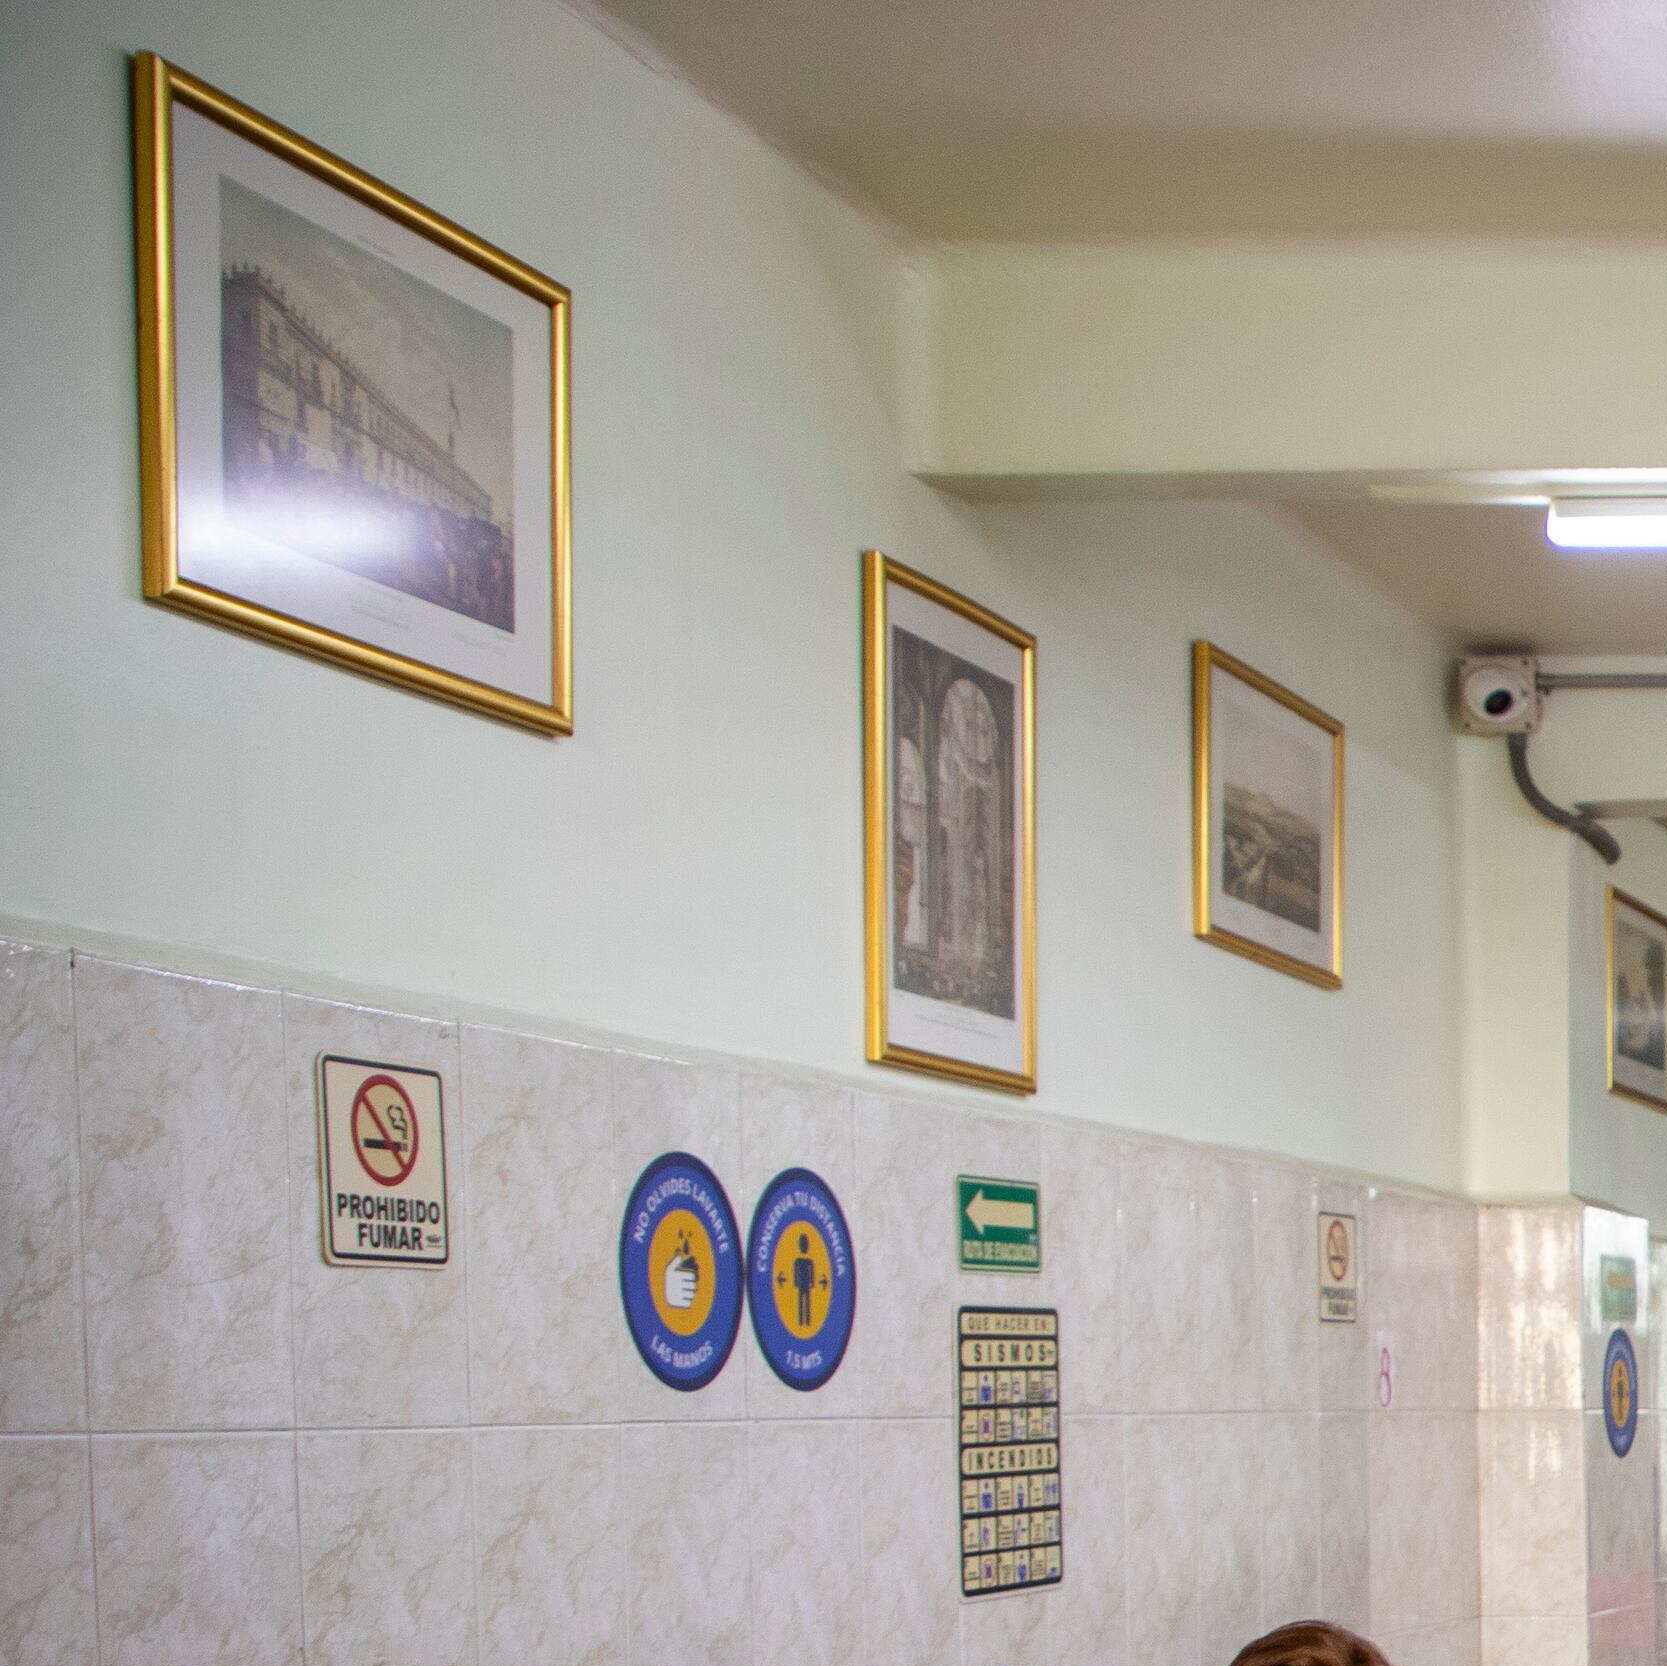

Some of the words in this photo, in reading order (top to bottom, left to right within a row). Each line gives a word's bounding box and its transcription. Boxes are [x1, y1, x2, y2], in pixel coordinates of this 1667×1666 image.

[337, 1193, 440, 1224] PROHIBIDO
[633, 1211, 650, 1243] NO
[647, 1177, 692, 1213] OLVIDES
[693, 1180, 729, 1254] LAVARTE
[358, 1223, 423, 1250] FUMAR
[756, 1194, 795, 1273] CONSERVA
[795, 1190, 809, 1208] TU
[809, 1194, 846, 1277] DISTANCIA
[651, 1335, 671, 1363] LAS
[673, 1340, 714, 1369] MANOS
[786, 1350, 802, 1367] 1.5
[802, 1350, 823, 1370] MTS
[974, 1343, 1045, 1362] SISMOS
[968, 1447, 1052, 1471] INCENDIOS
